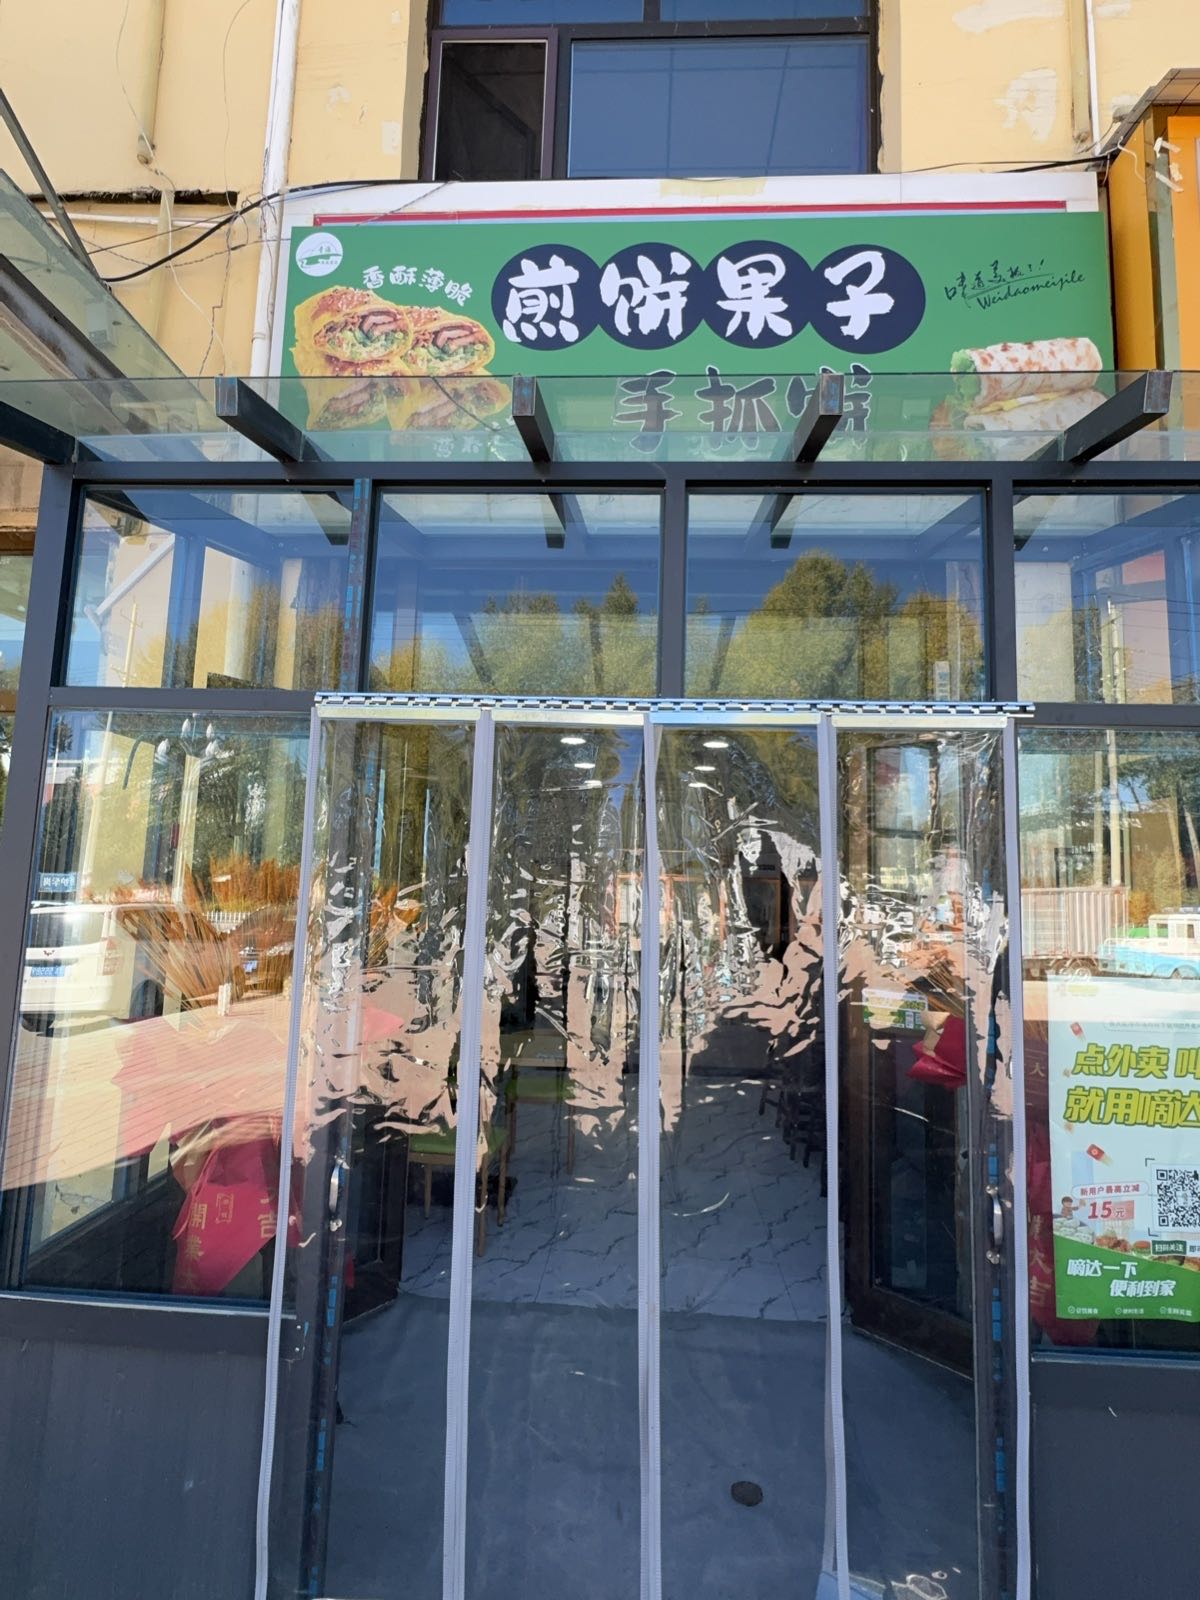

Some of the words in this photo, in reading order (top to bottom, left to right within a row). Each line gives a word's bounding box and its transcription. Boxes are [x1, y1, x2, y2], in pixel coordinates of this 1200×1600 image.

[362, 265, 473, 307] 香酥薄脆
[503, 251, 895, 342] 煎饼果子
[1071, 1043, 1170, 1079] 点外卖
[1080, 1184, 1140, 1196] 新用户最高立减
[1088, 1200, 1126, 1220] 15元
[1110, 1279, 1177, 1297] 便利到家
